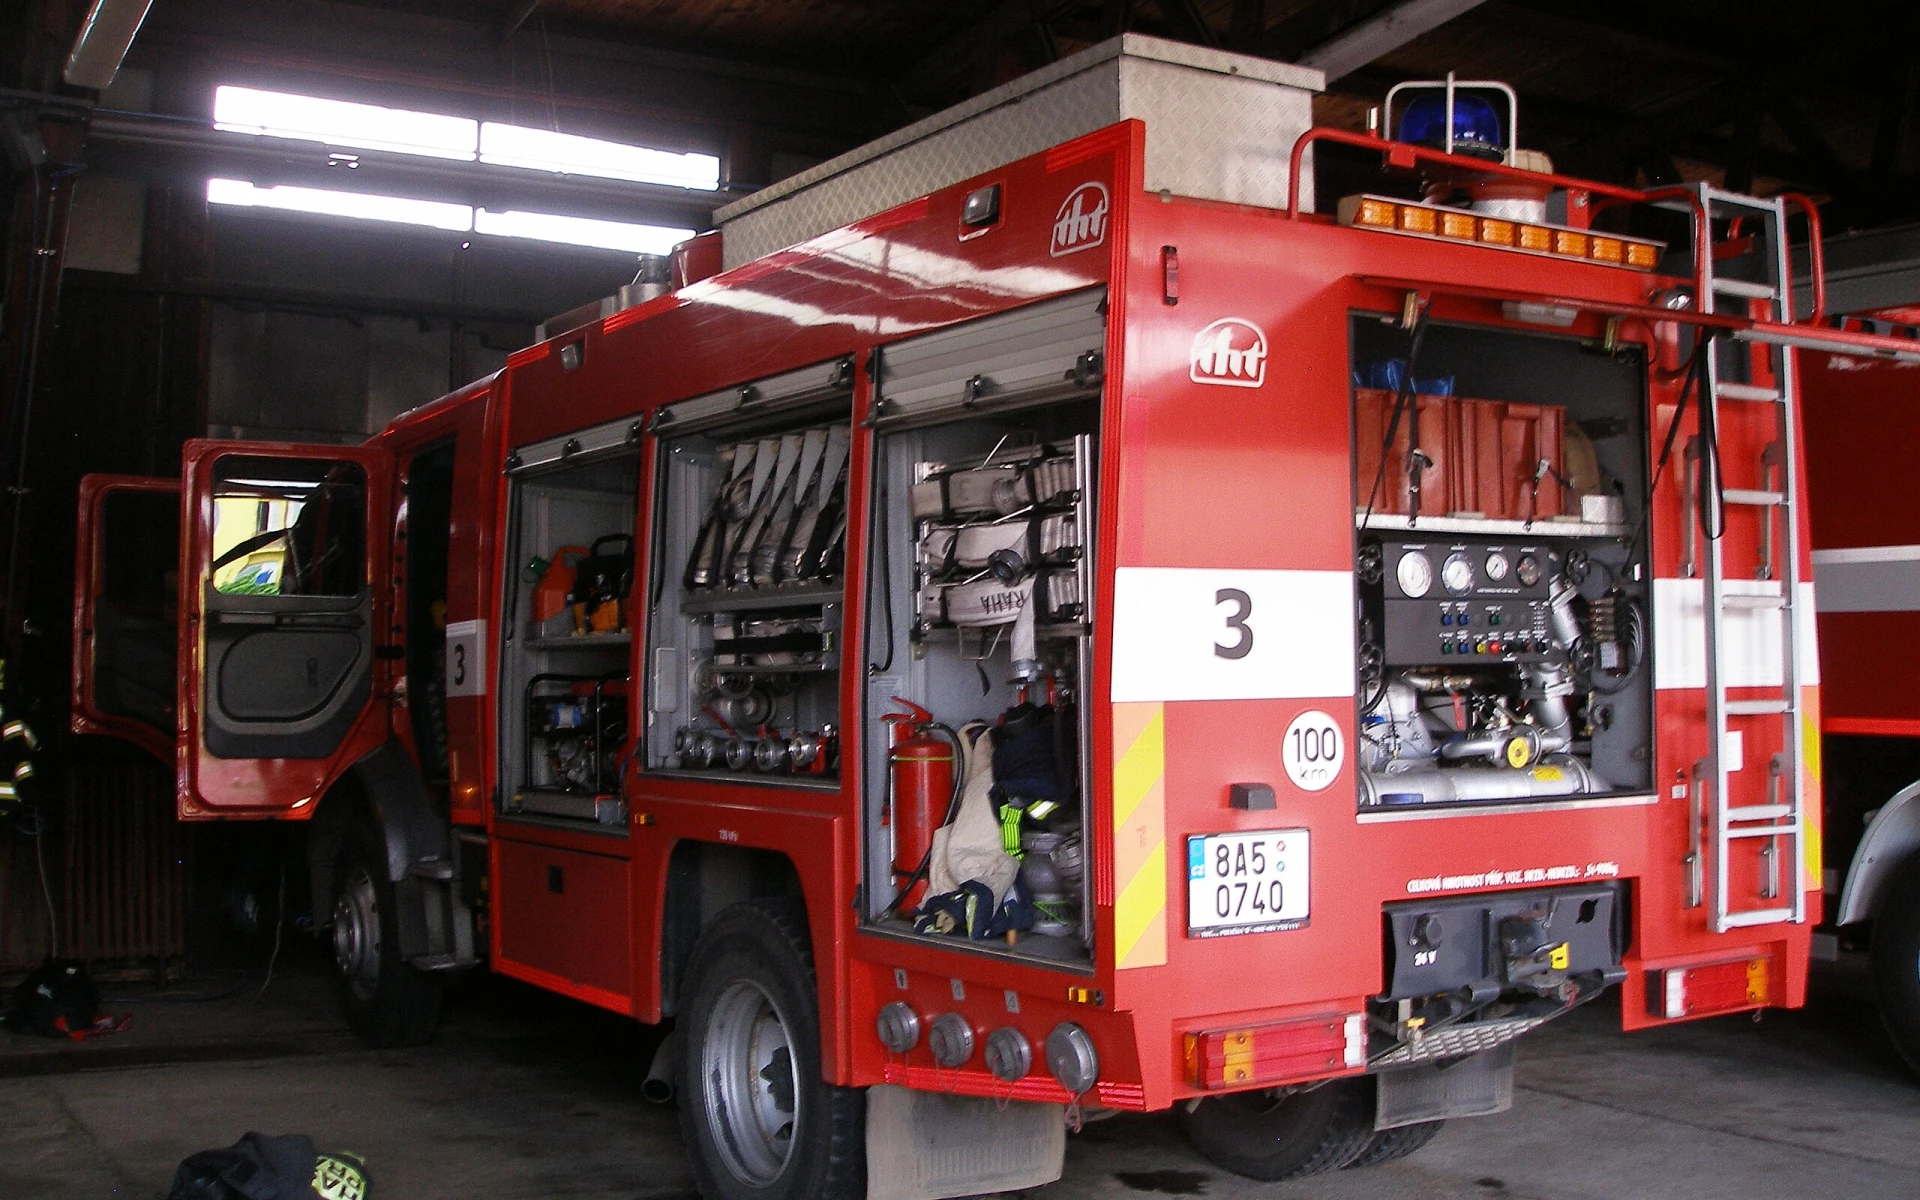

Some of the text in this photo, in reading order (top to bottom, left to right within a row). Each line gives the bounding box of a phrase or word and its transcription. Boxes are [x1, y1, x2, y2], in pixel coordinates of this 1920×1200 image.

[1213, 587, 1253, 660] 3
[454, 643, 465, 686] 3
[1293, 727, 1336, 763] 100
[1300, 765, 1328, 780] km
[1216, 841, 1266, 877] 8A5
[1216, 880, 1283, 918] 0740
